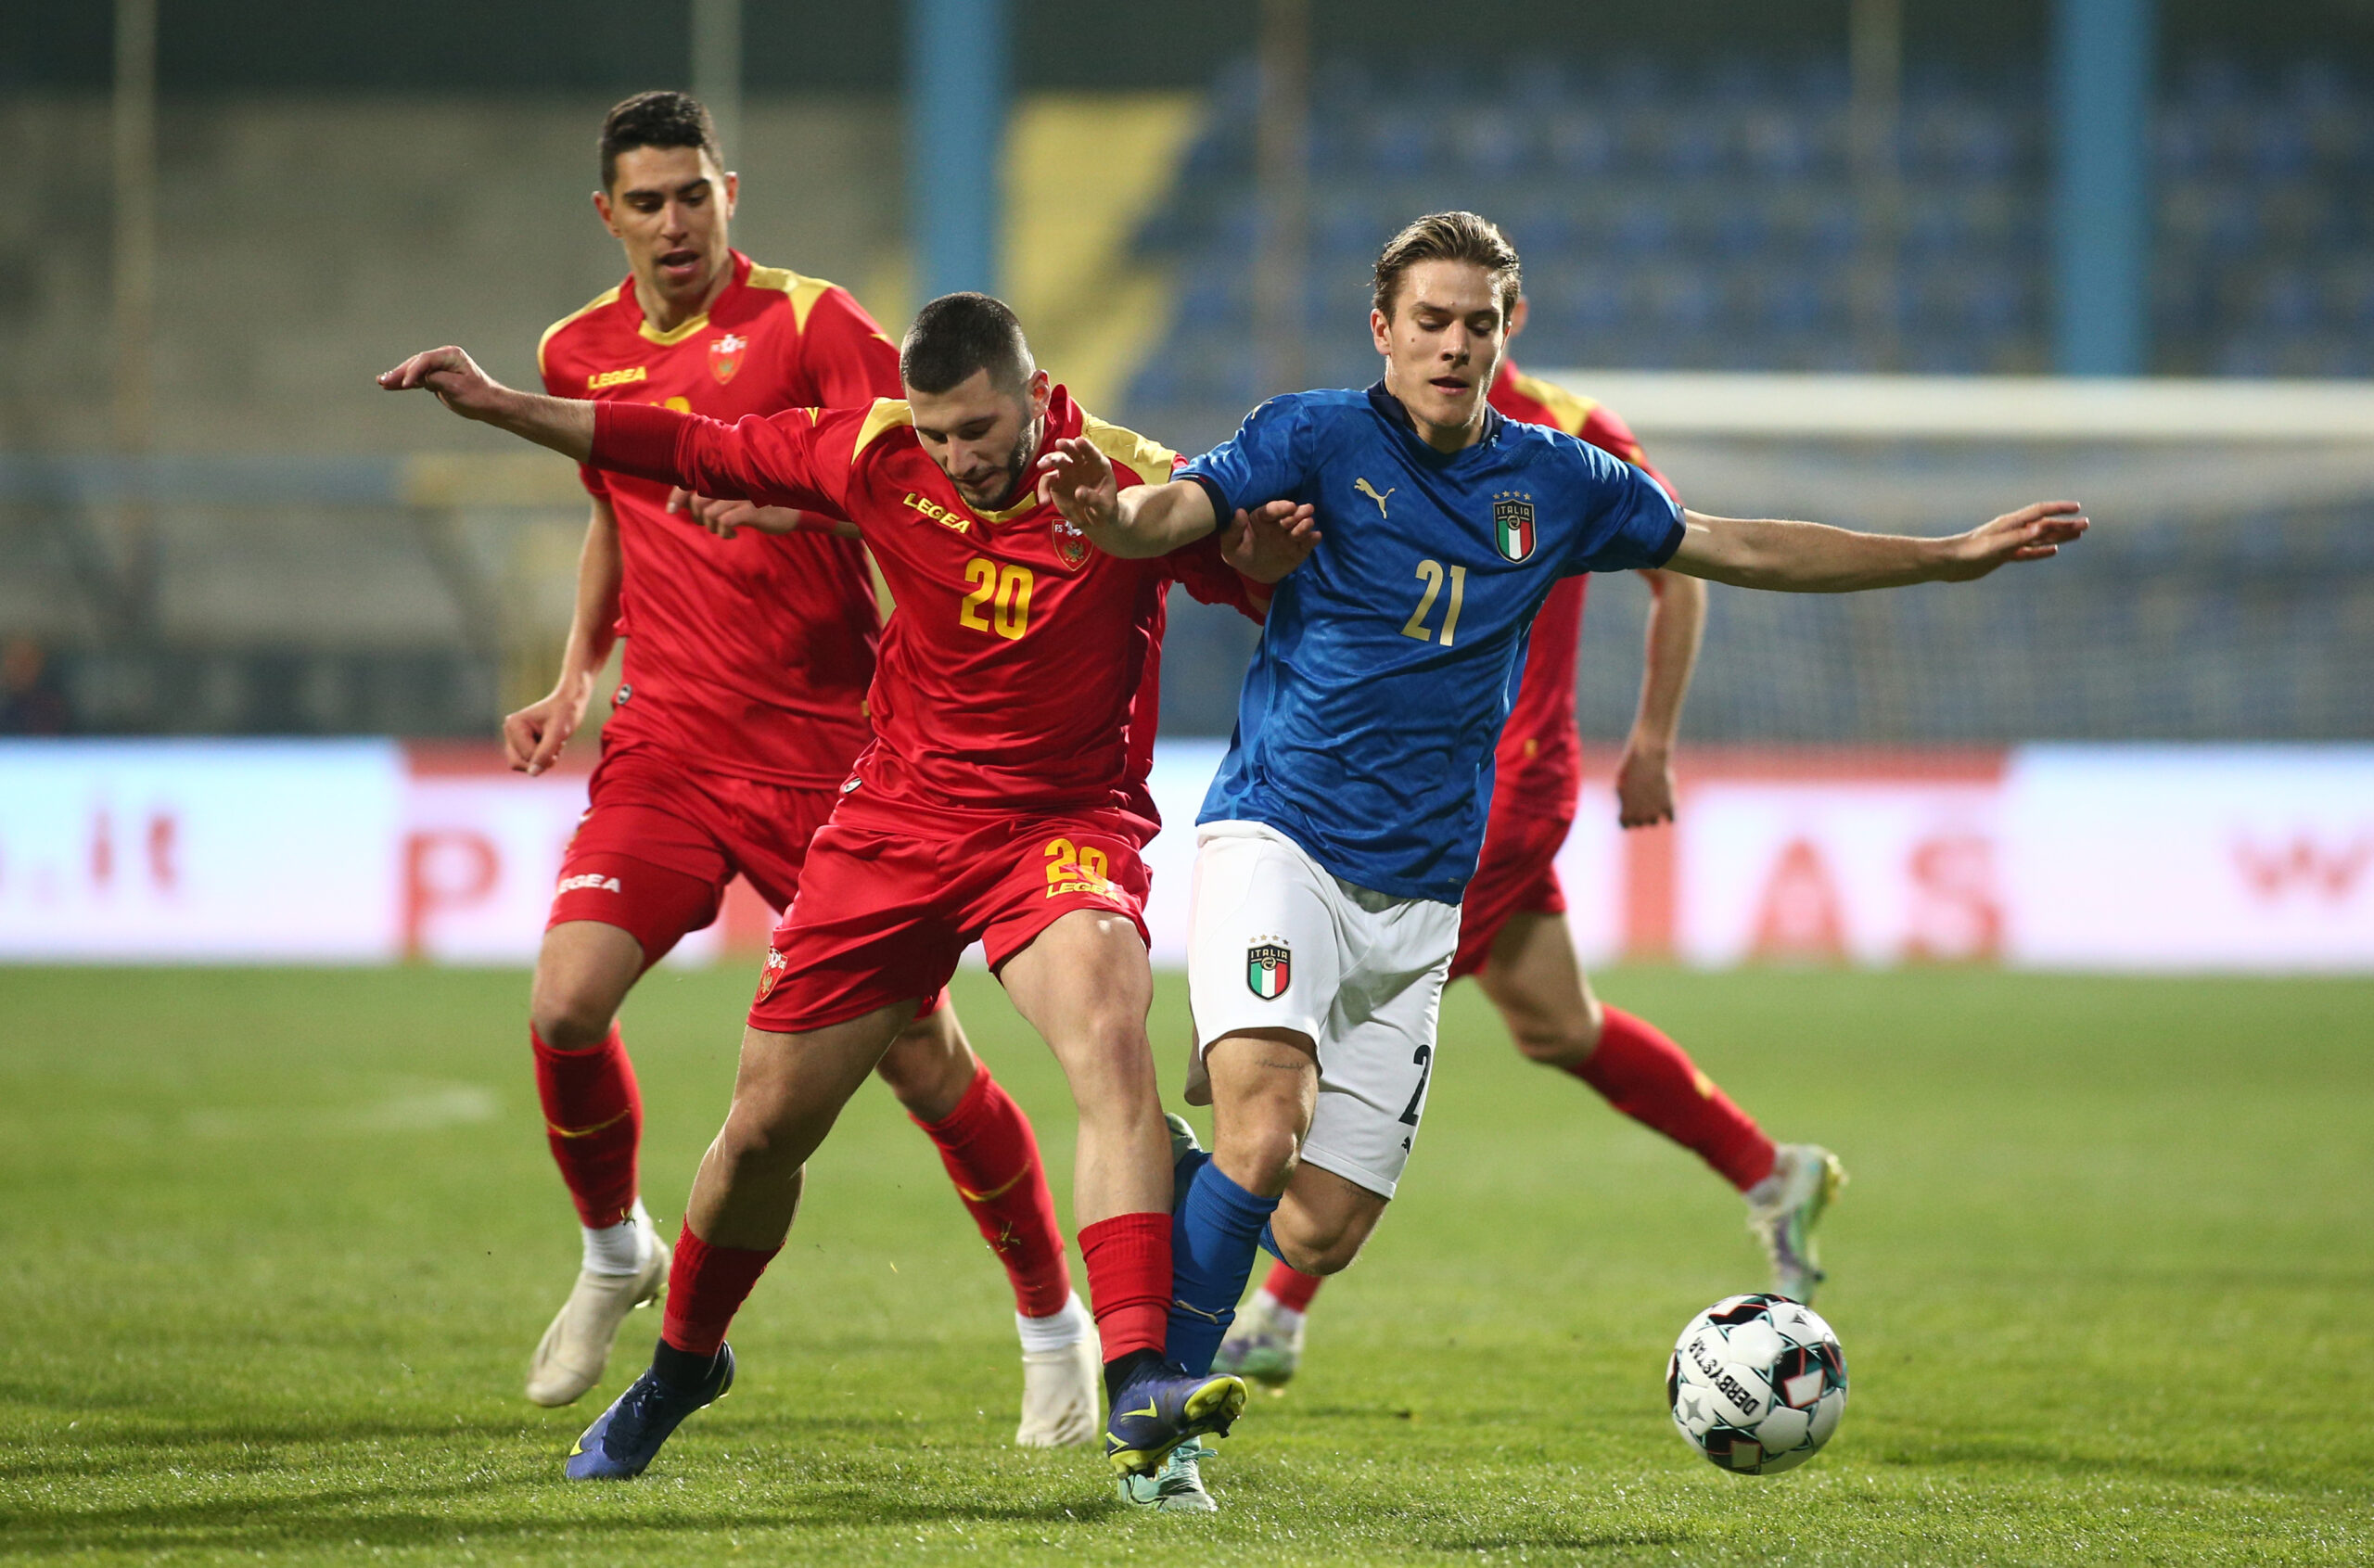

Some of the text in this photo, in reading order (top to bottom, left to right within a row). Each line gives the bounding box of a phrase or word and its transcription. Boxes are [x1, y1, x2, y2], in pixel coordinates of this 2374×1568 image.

[588, 365, 646, 390] LEGEA
[902, 492, 971, 534] LEGEA
[1496, 505, 1531, 518] ITALIA
[959, 557, 1034, 641] 20
[1400, 559, 1467, 646] 21
[1044, 837, 1108, 888] 20
[556, 873, 620, 894] EGEA
[1045, 882, 1120, 903] LEGEA
[1250, 948, 1288, 960] ITALIA
